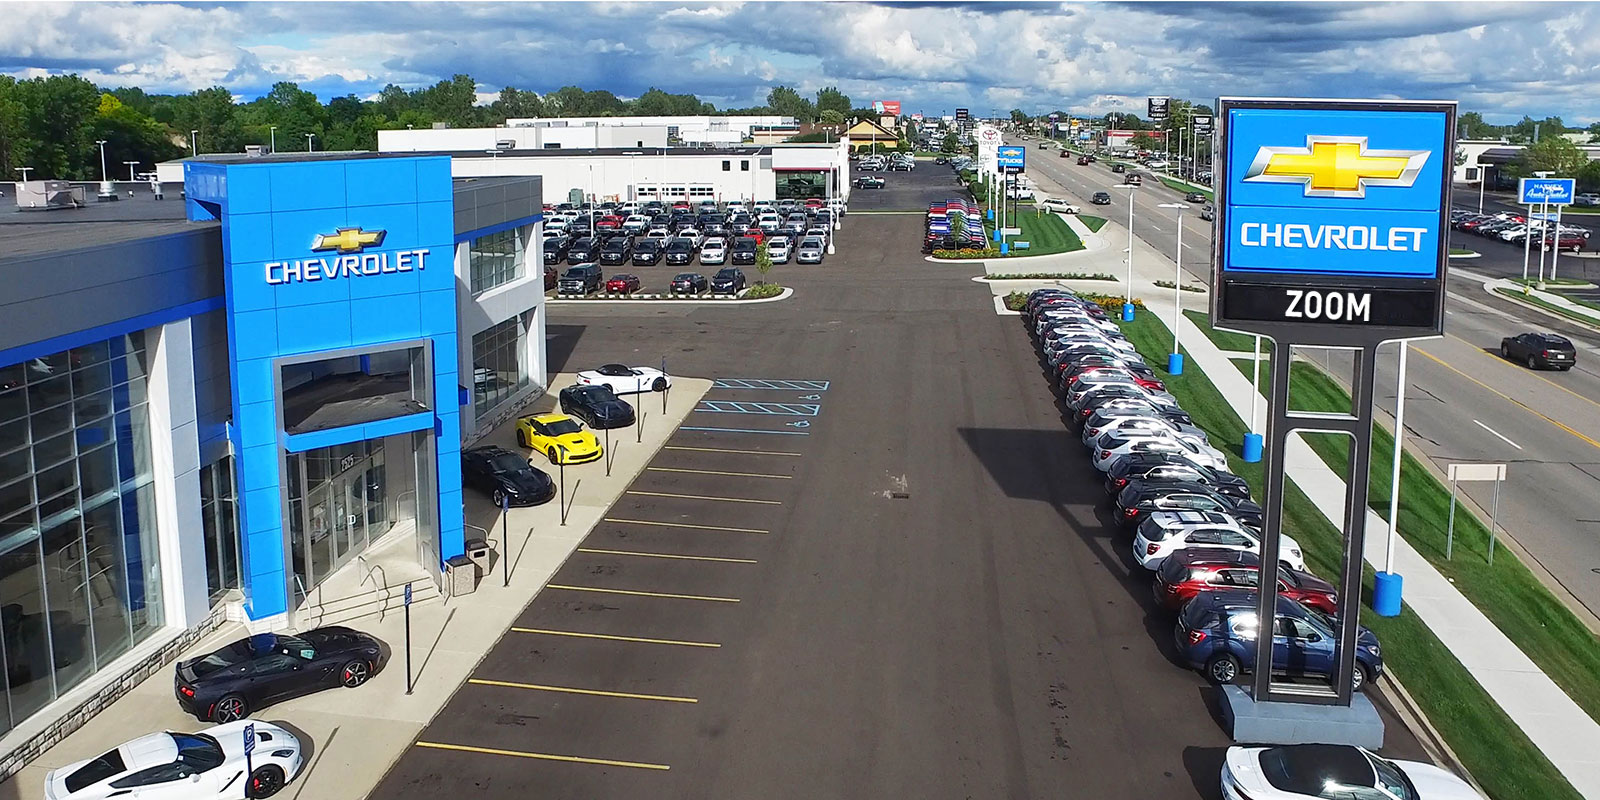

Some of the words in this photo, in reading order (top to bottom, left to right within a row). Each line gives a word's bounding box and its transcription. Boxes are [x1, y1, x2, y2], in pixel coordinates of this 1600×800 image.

[1240, 222, 1428, 252] CHEVROLET
[264, 249, 429, 284] CHEVROLET
[1284, 290, 1372, 322] ZOOM
[341, 453, 354, 472] 2525
